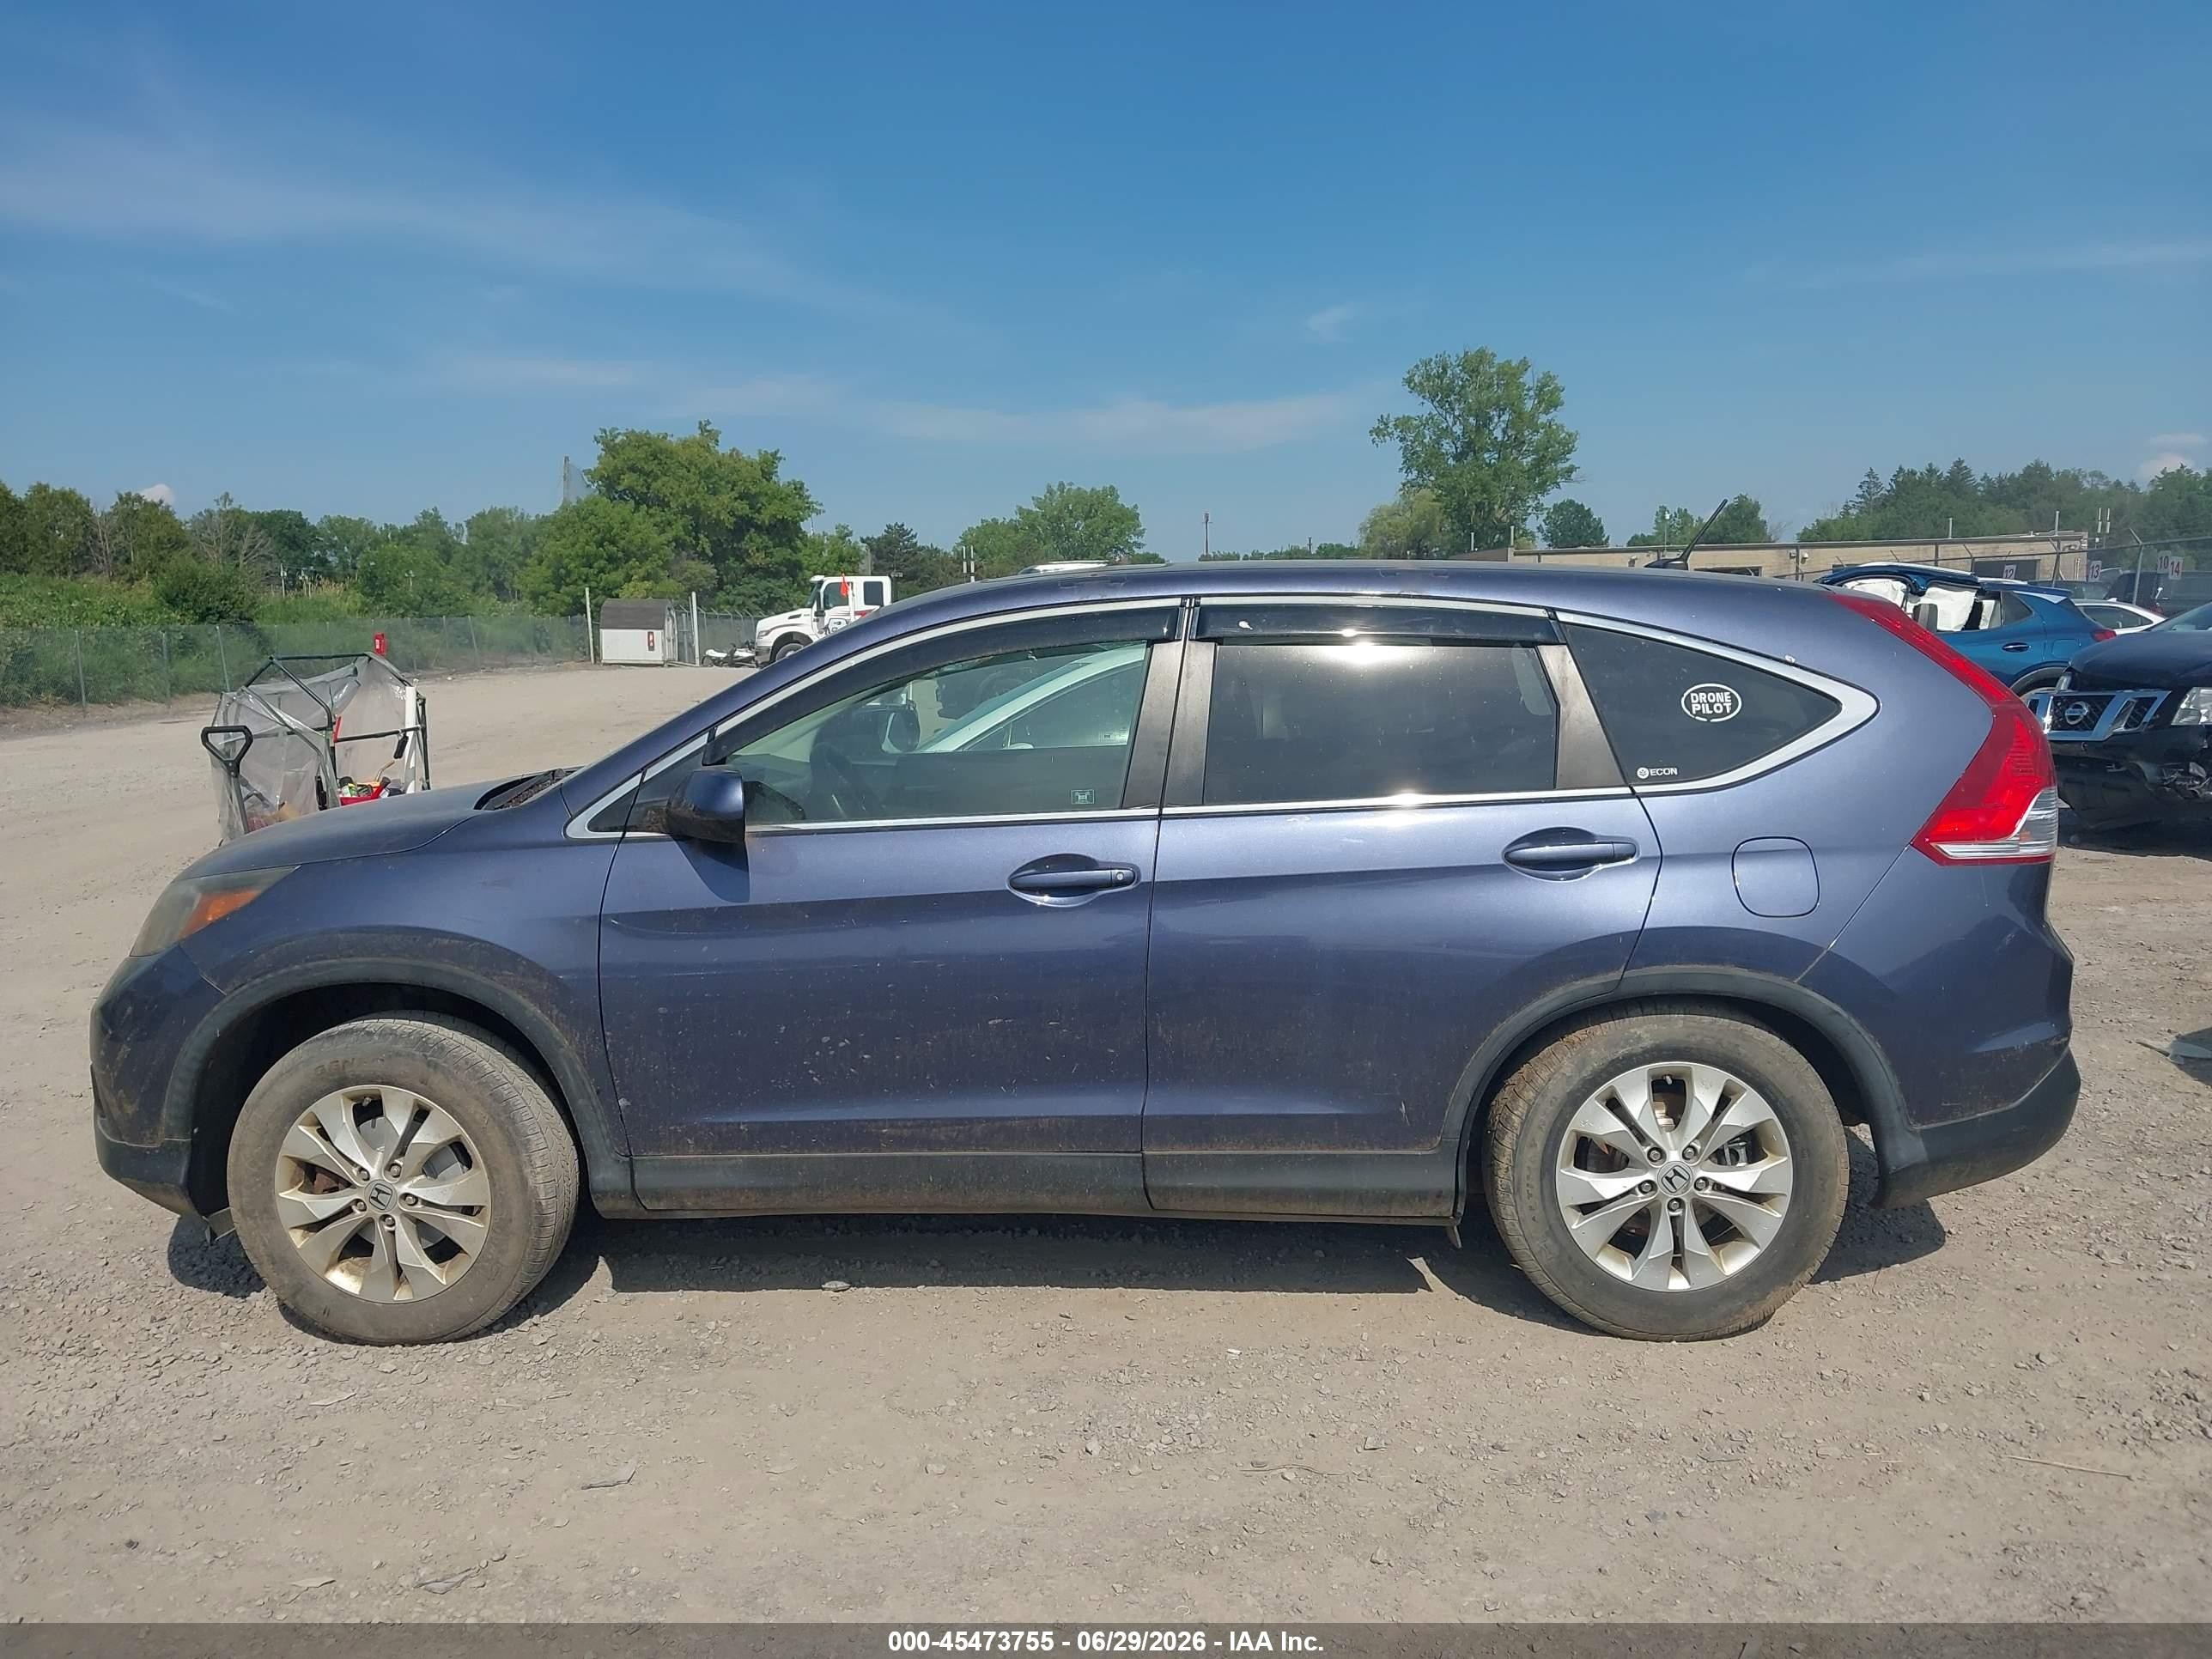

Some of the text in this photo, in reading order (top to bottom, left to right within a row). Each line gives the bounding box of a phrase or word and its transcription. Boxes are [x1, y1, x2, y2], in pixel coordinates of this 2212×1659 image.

[2159, 556, 2169, 568] 10
[2090, 564, 2100, 579] 13
[2171, 561, 2180, 576] 14
[1690, 691, 1732, 703] DRONE
[1691, 702, 1732, 714] PILOT
[1650, 767, 1679, 776] ECON
